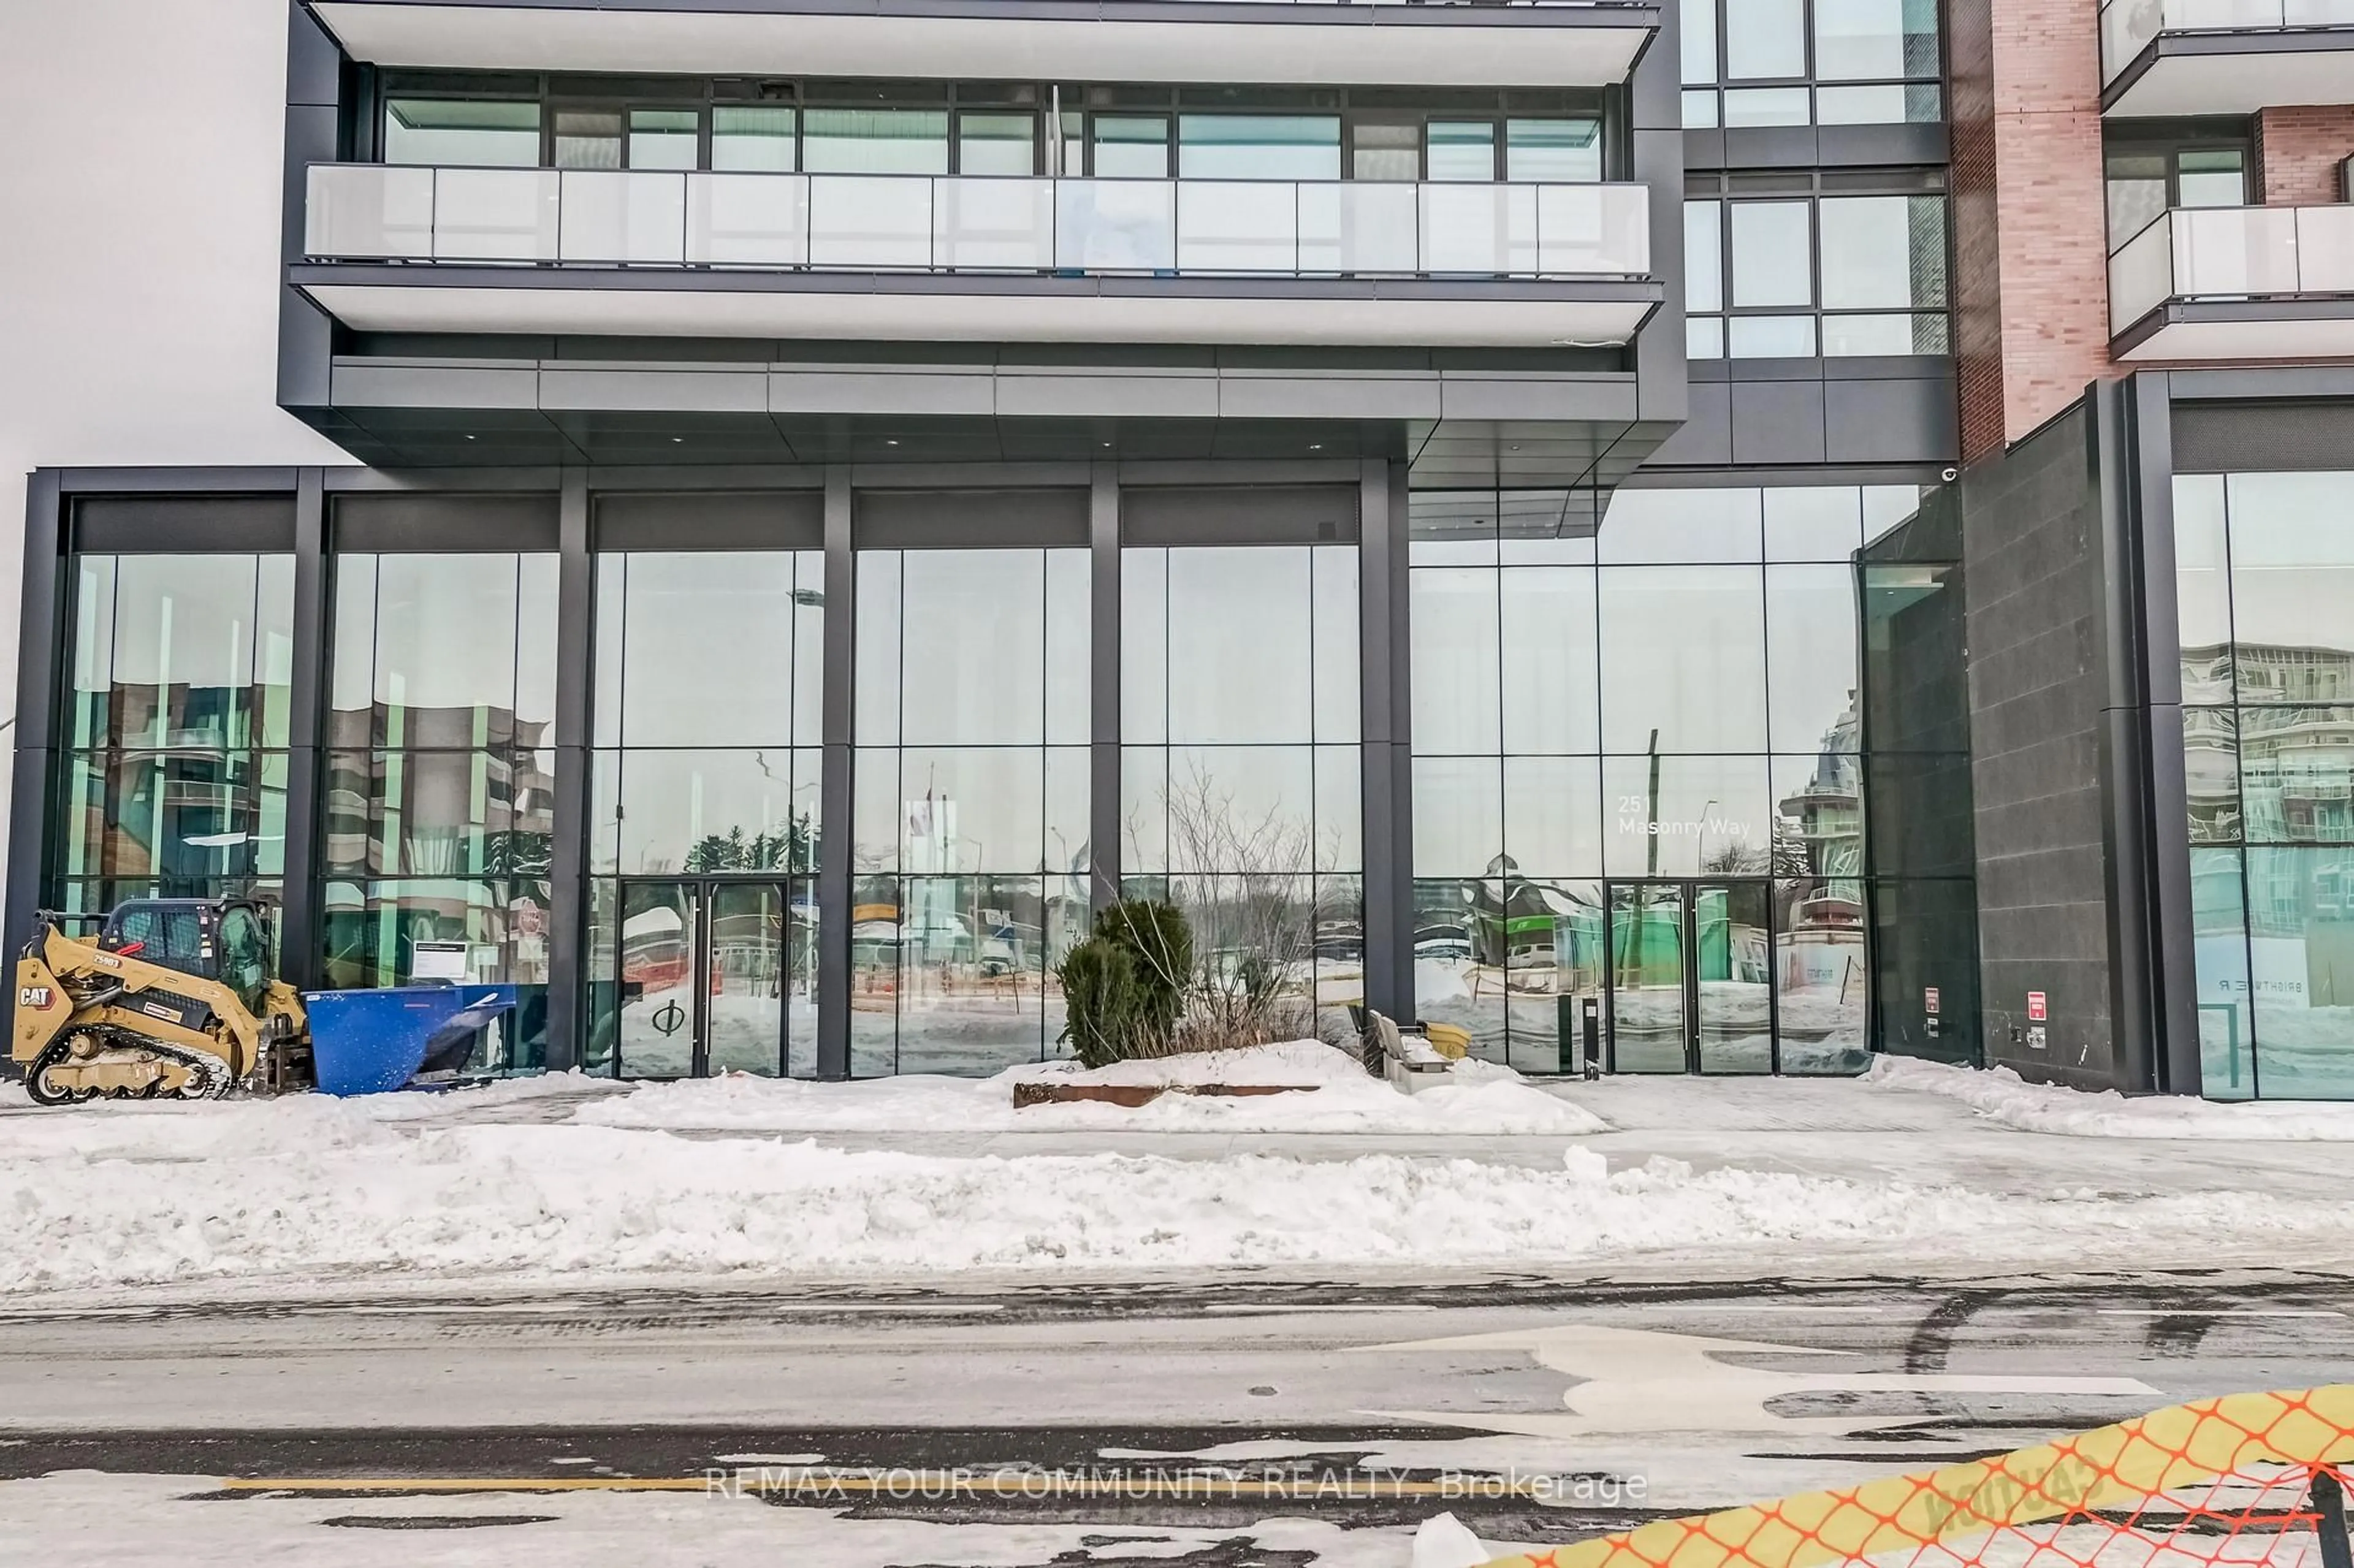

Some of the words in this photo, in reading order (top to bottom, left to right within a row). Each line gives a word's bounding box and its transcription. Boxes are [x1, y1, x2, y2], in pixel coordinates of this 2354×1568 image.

[1619, 818, 1704, 838] Masonry
[1709, 818, 1750, 839] Way
[20, 988, 49, 1007] CAT
